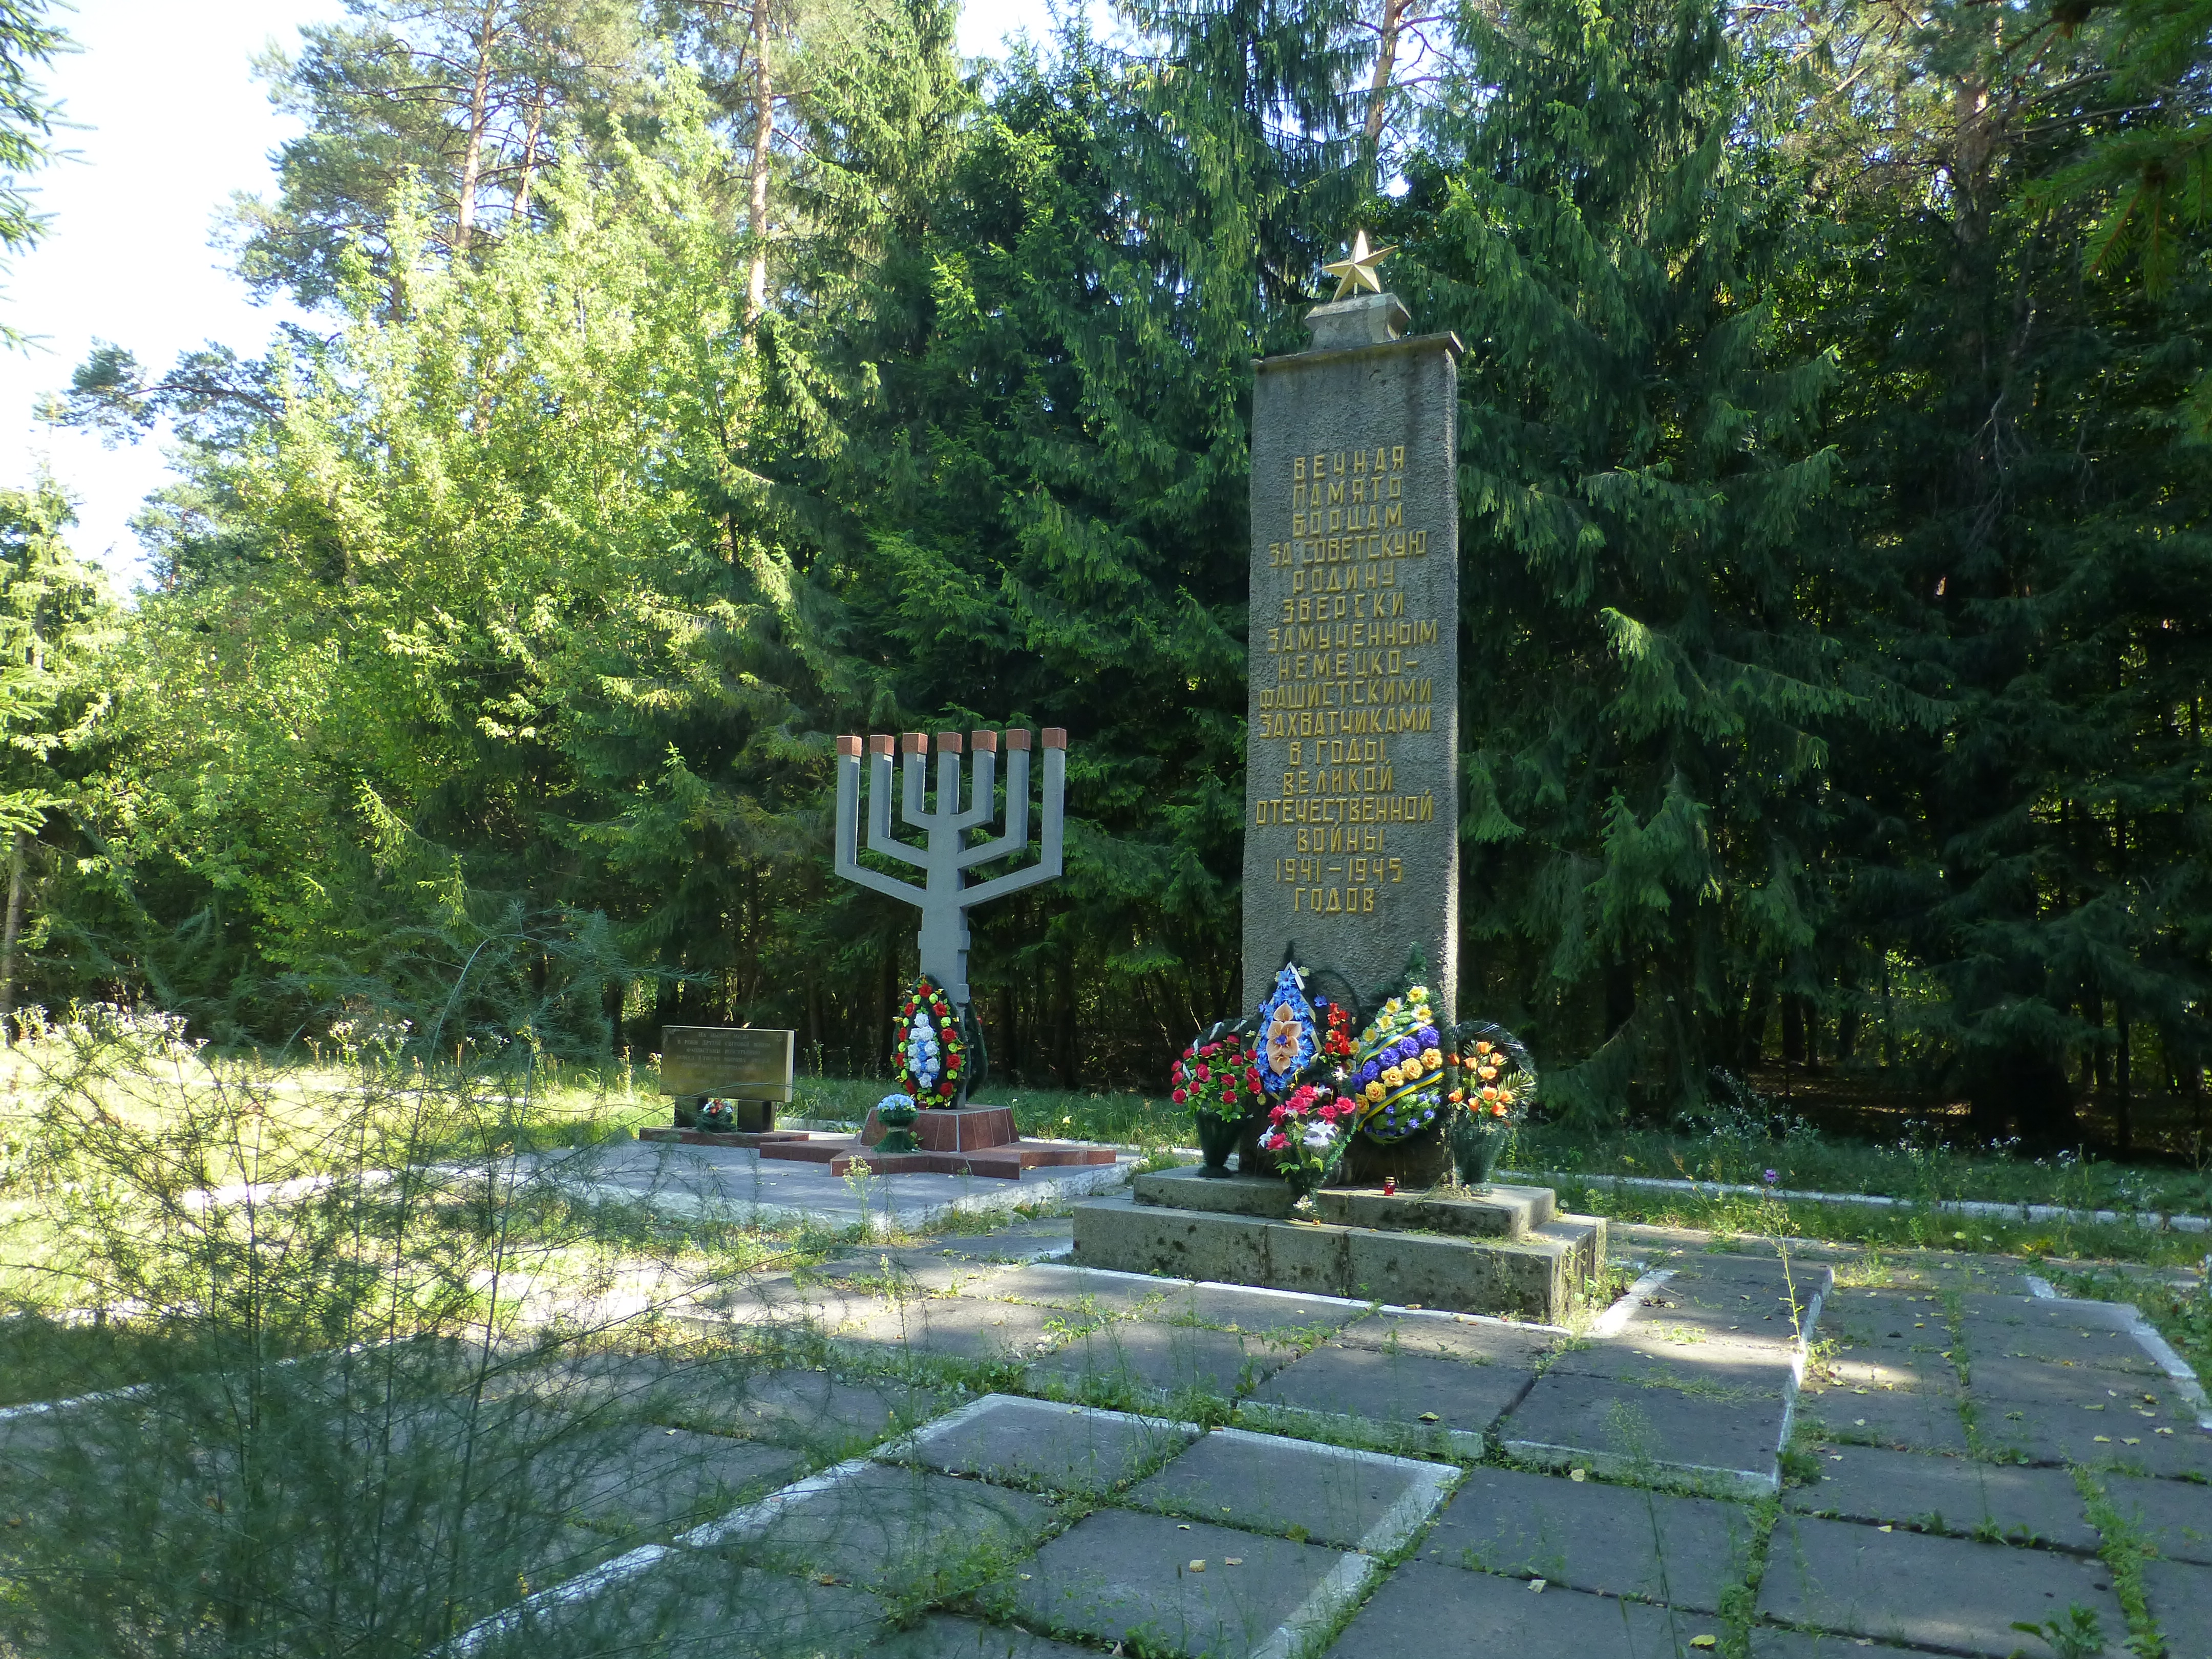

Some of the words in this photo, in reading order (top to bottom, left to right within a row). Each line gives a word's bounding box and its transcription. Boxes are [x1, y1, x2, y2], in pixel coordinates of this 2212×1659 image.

[1294, 445, 1405, 481] ВЕЧНАЯ
[1292, 503, 1402, 538] БОРЦАМ
[1268, 542, 1293, 567] ЗА
[1302, 530, 1428, 563] СОВЕТСКУЮ
[1293, 562, 1395, 594] РОДИНУ
[1283, 592, 1404, 624] ЗВЕРСКИ
[1267, 619, 1438, 653] ЗАМУЧЕННЫМ
[1279, 650, 1418, 680] НЕМЕЦКО-
[1260, 678, 1432, 710] ФАШИСТСКИМИ
[1260, 707, 1431, 738] ЗАХВАТЧИКАМИ
[1290, 741, 1302, 766] В
[1316, 738, 1385, 765] ГОДЫ
[1283, 759, 1393, 796] ВЕЛИКОЙ
[1256, 789, 1433, 824] ОТЕЧЕСТВЕННОЙ
[1298, 822, 1384, 853] ВОЙНЫ
[1295, 887, 1374, 912] ГОДОВ
